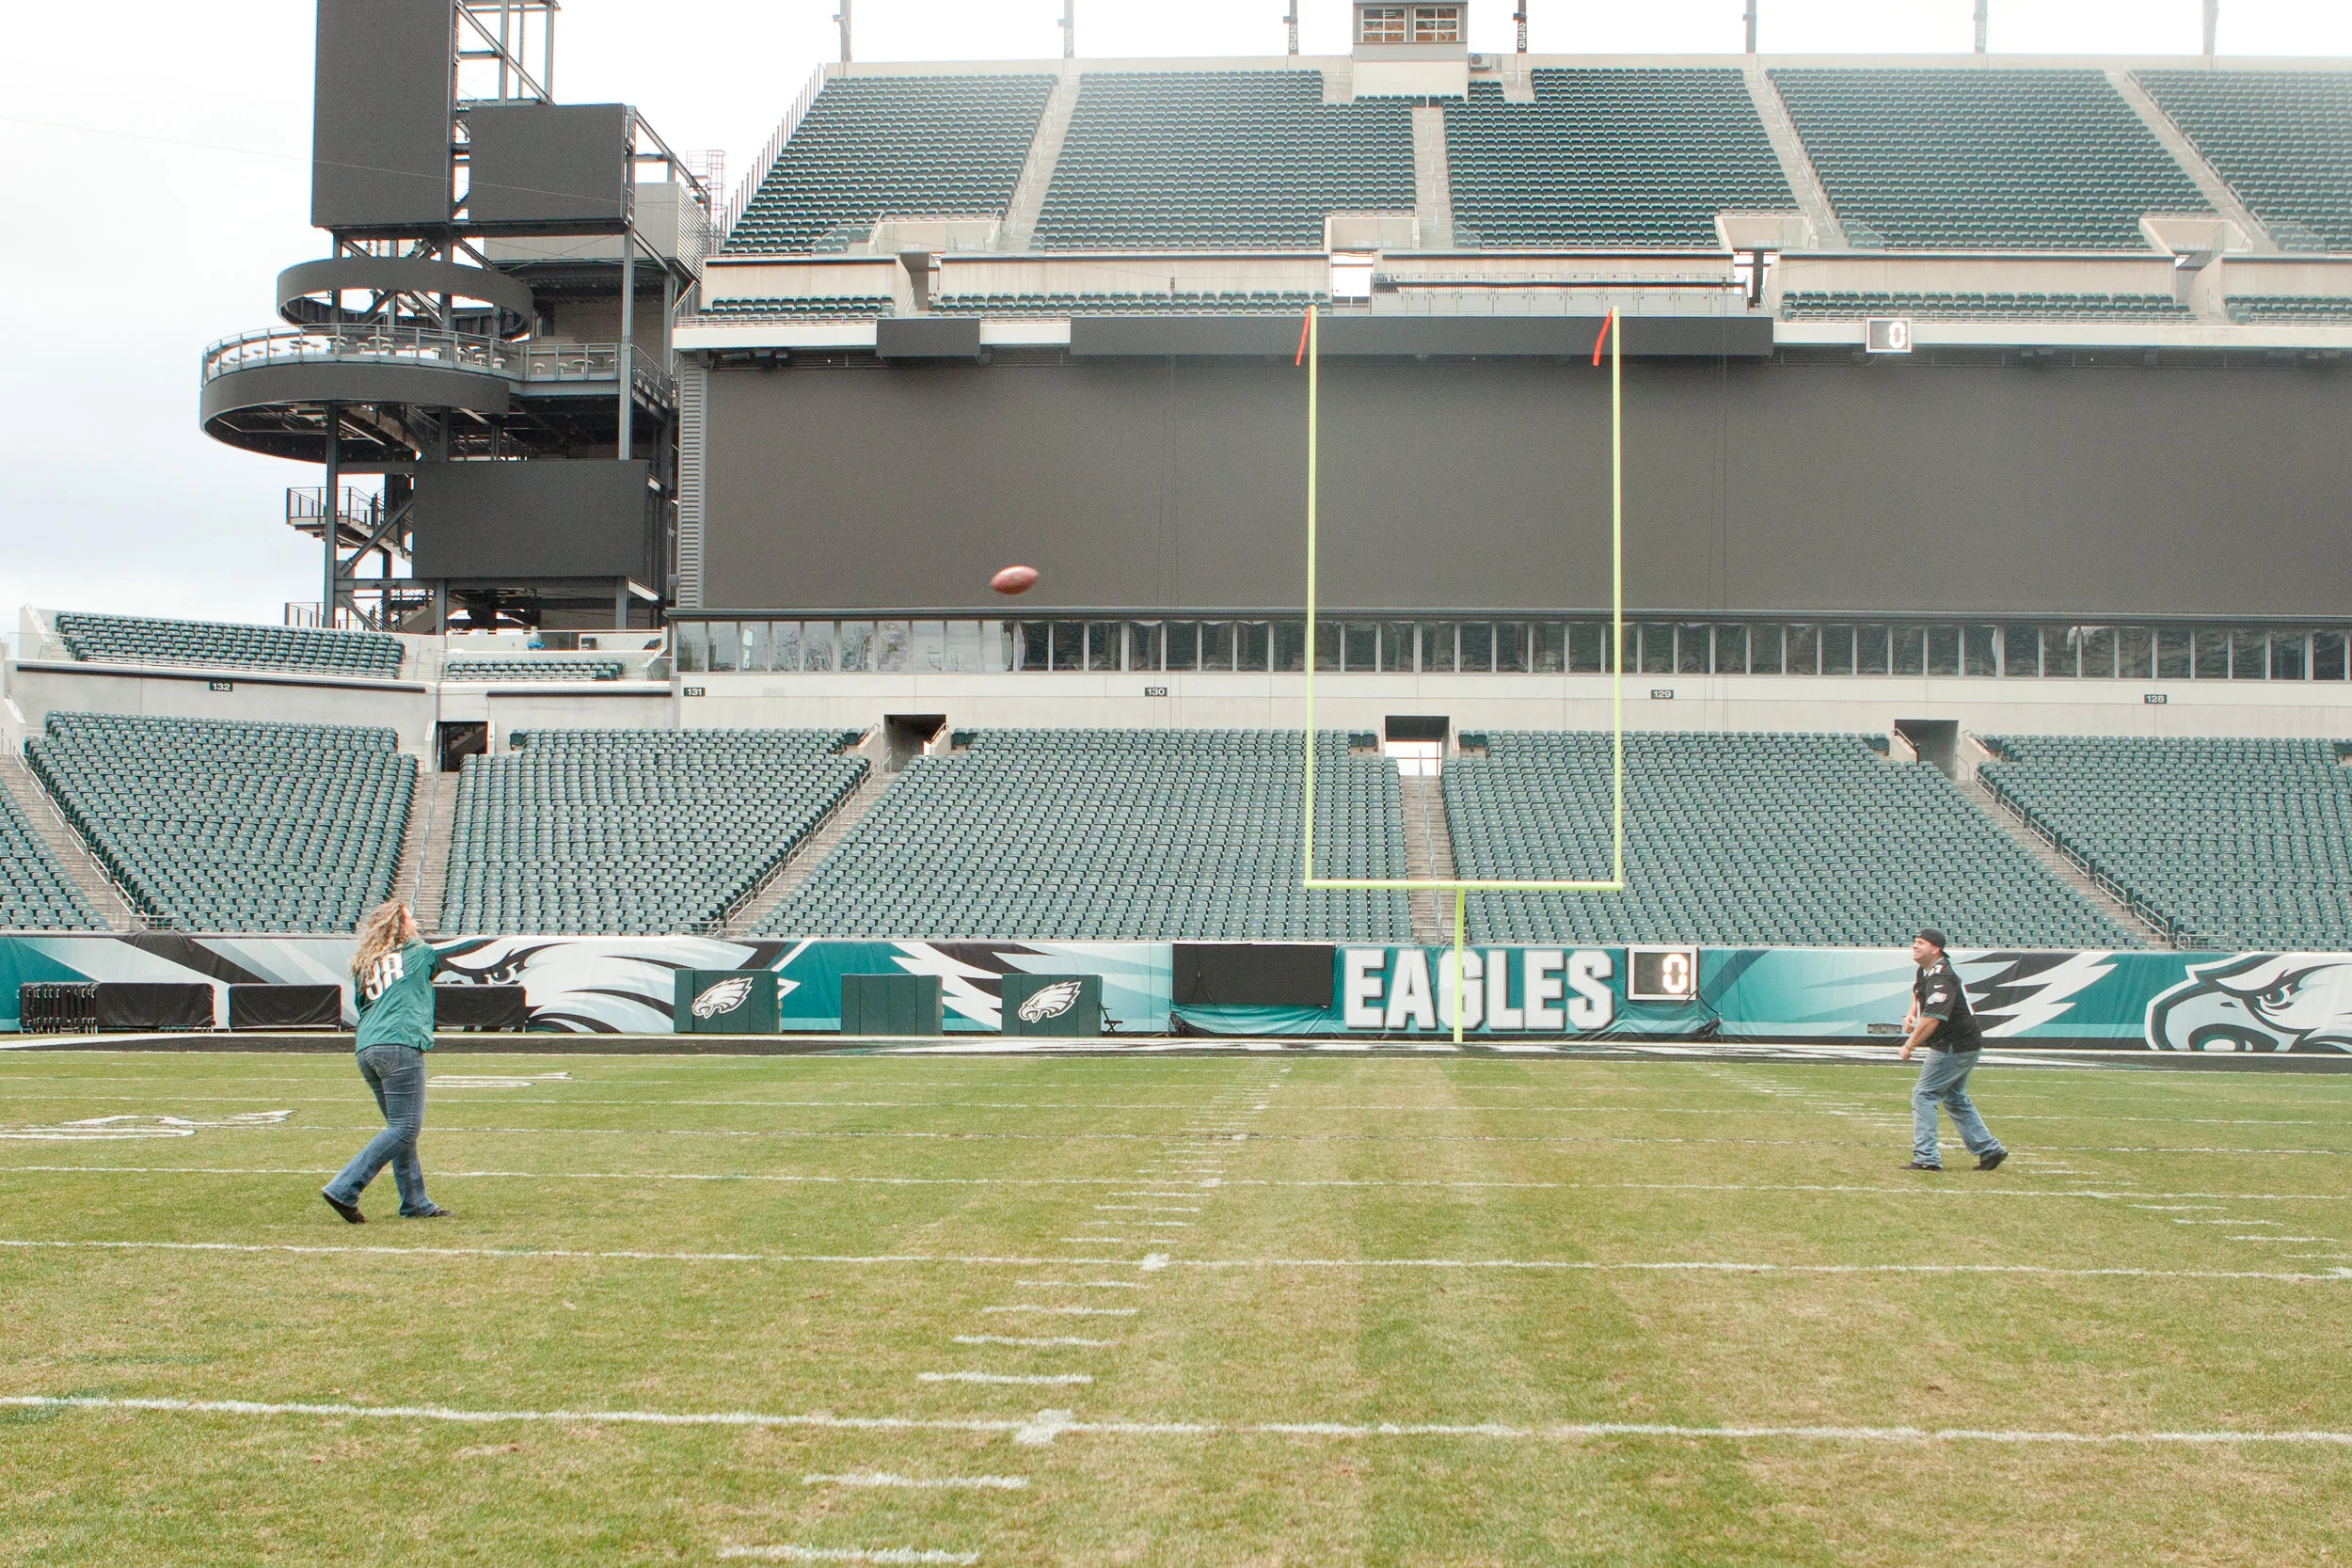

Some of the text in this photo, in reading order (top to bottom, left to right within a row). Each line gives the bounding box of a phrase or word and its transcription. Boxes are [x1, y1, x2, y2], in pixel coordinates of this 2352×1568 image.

[1889, 322, 1905, 348] 0
[212, 682, 230, 691] 132
[687, 688, 703, 696] 131
[1147, 688, 1165, 696] 130
[1653, 690, 1672, 699] 129
[2146, 695, 2165, 704] 128
[1662, 953, 1688, 994] 0
[1344, 948, 1613, 1030] EAGLES
